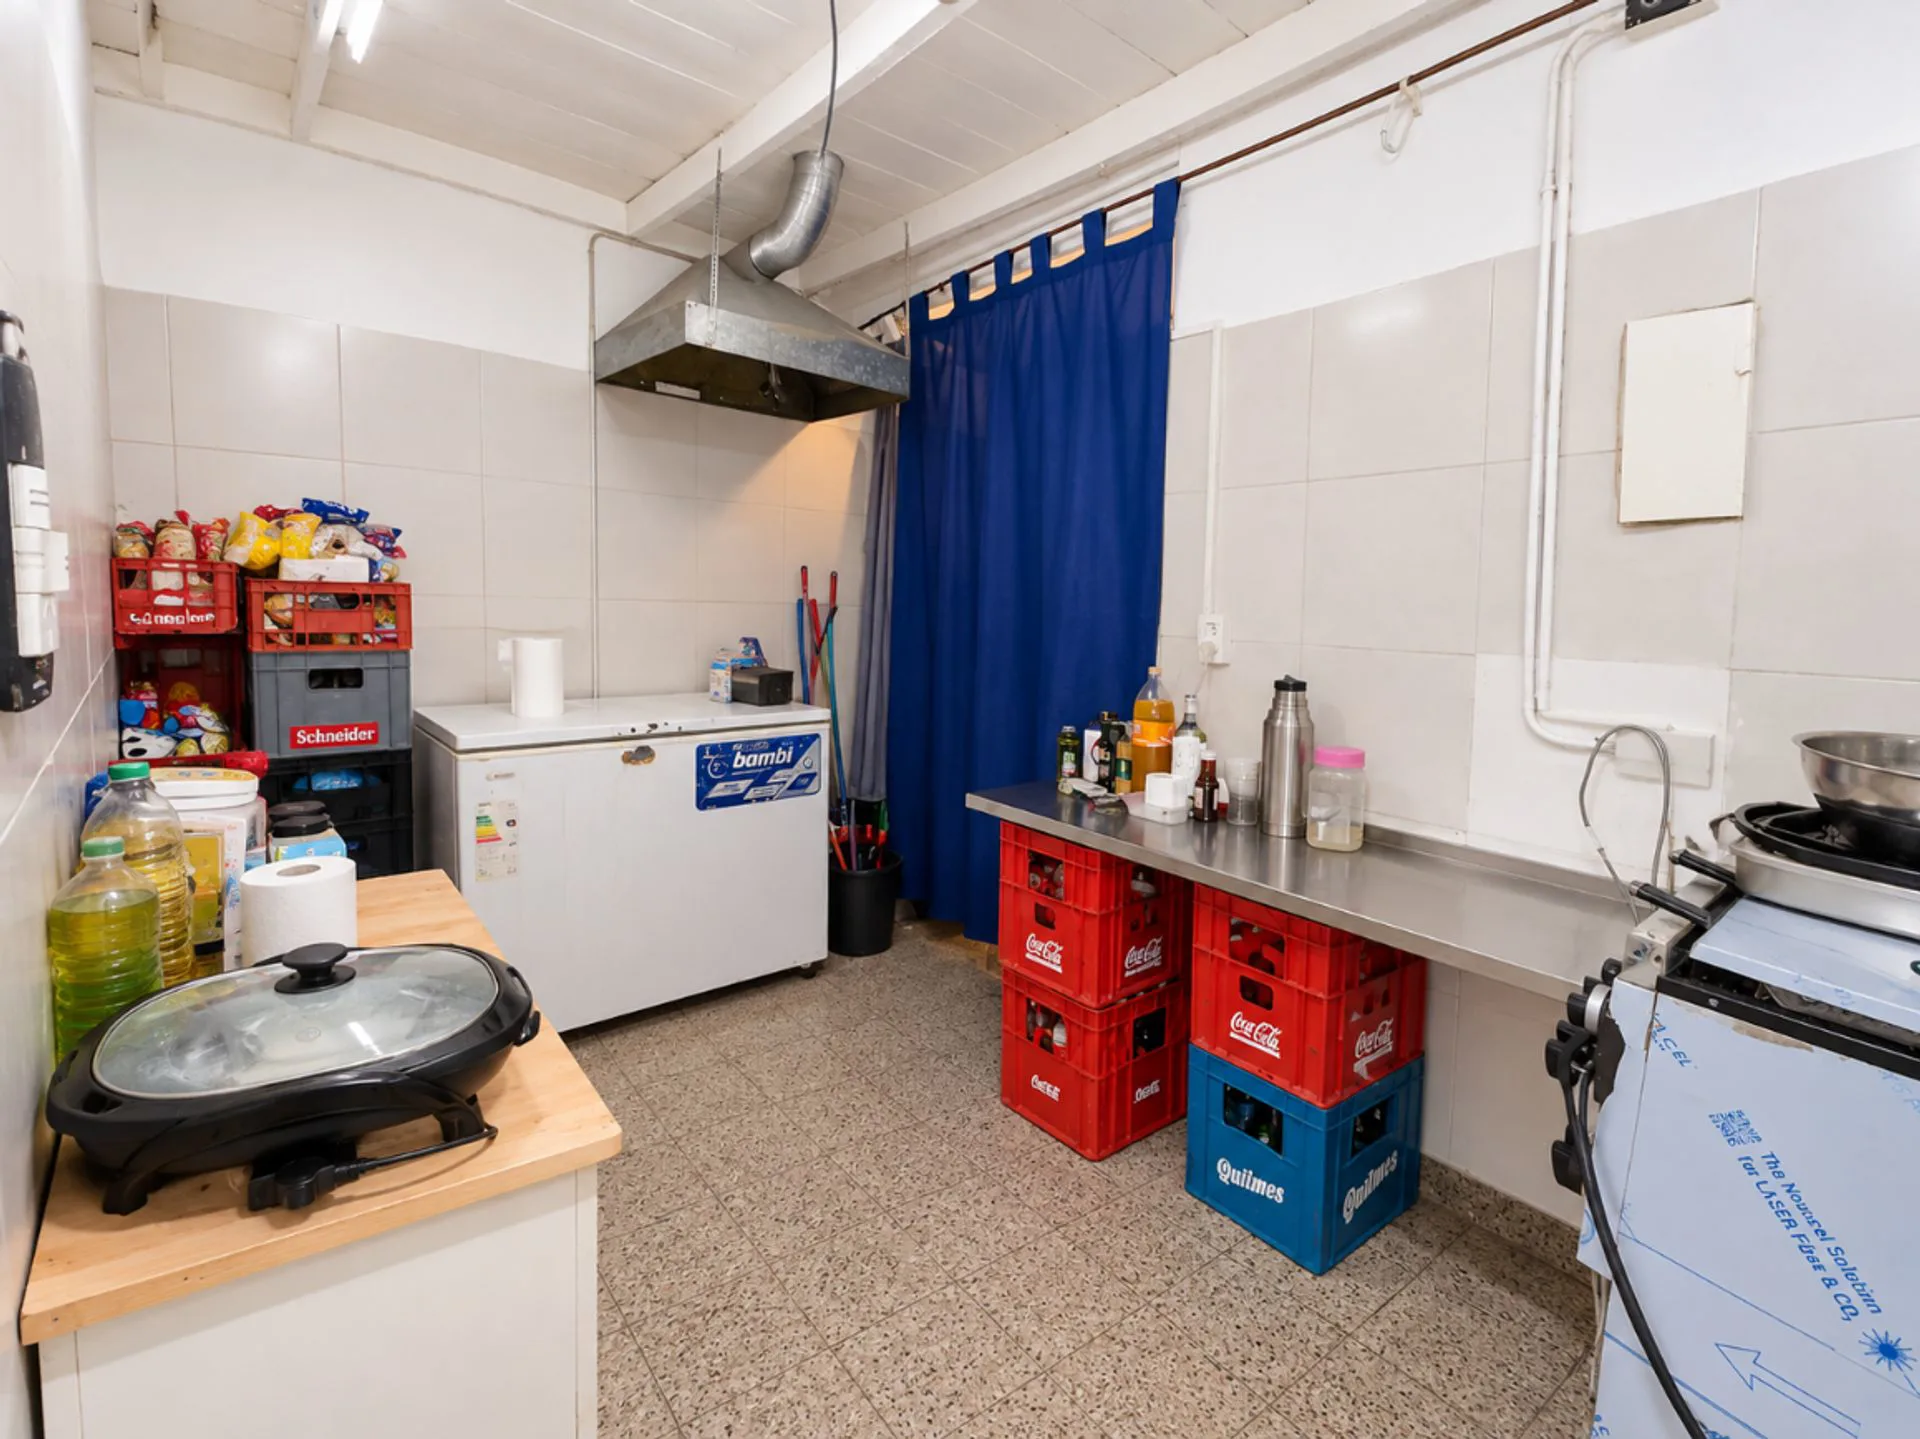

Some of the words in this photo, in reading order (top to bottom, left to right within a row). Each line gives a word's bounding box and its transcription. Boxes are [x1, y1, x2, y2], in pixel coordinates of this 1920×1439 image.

[296, 726, 376, 745] Schneider
[732, 746, 794, 769] bambi
[1216, 1157, 1286, 1204] Quilmes
[1342, 1149, 1398, 1225] Quilmes
